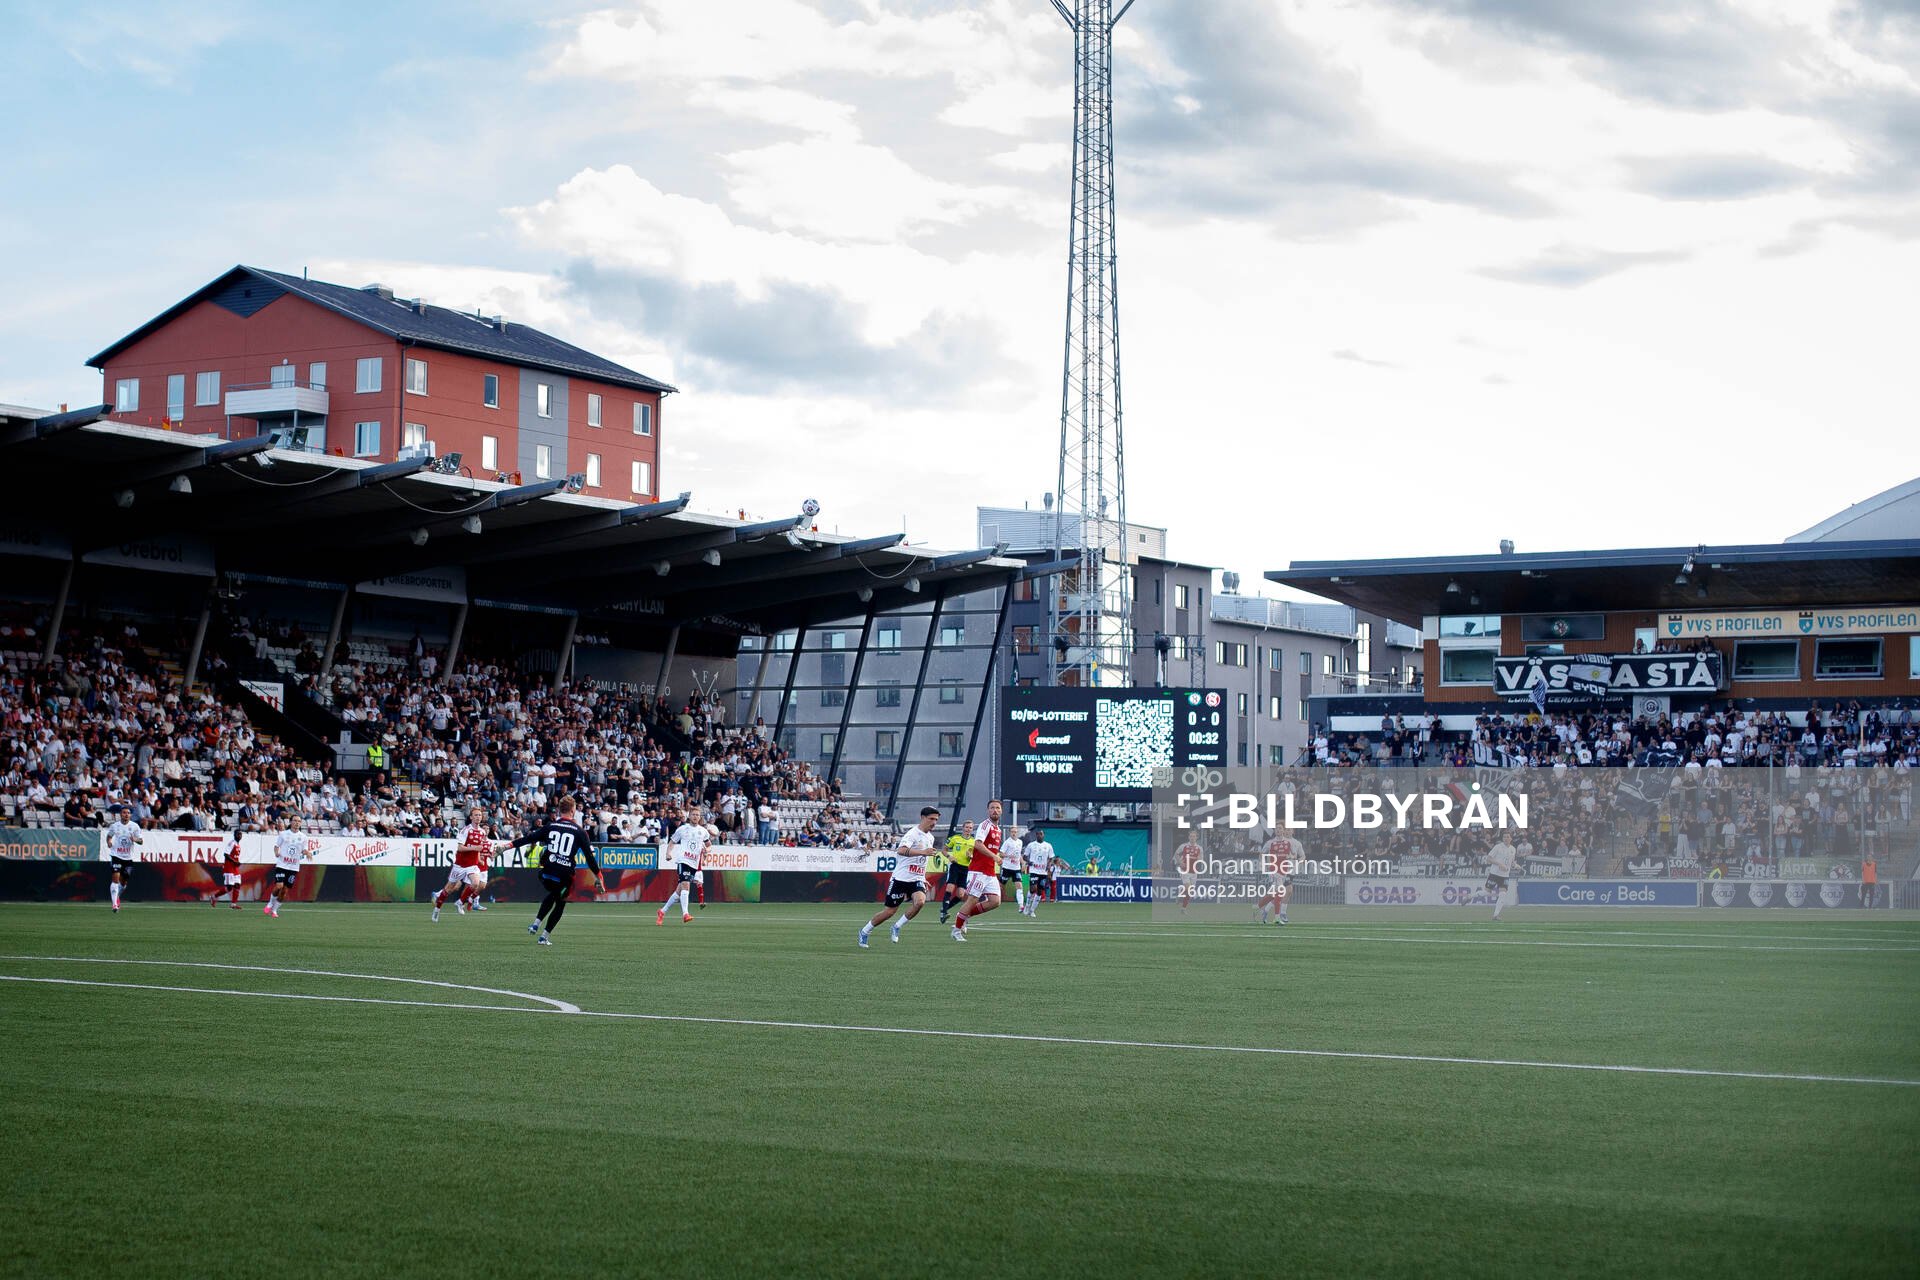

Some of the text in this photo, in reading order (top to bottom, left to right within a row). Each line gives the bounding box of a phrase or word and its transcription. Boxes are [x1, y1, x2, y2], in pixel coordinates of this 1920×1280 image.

[1686, 619, 1712, 632] VVS
[1817, 615, 1844, 628] VVS
[1648, 652, 1715, 687] STÅ
[1011, 709, 1089, 723] 50/50-LOTTERIET
[1188, 711, 1197, 726] 0
[1211, 711, 1220, 726] 0
[1188, 732, 1219, 745] 00:32
[1025, 762, 1035, 773] 11
[1058, 762, 1074, 774] KR
[547, 830, 575, 857] 30
[345, 840, 390, 864] Radiator
[603, 851, 655, 867] RÖRTJÄNST
[1061, 882, 1135, 898] LINDSTRÖM
[1358, 881, 1417, 904] ÖBAB
[1557, 884, 1656, 904] Care of Beds
